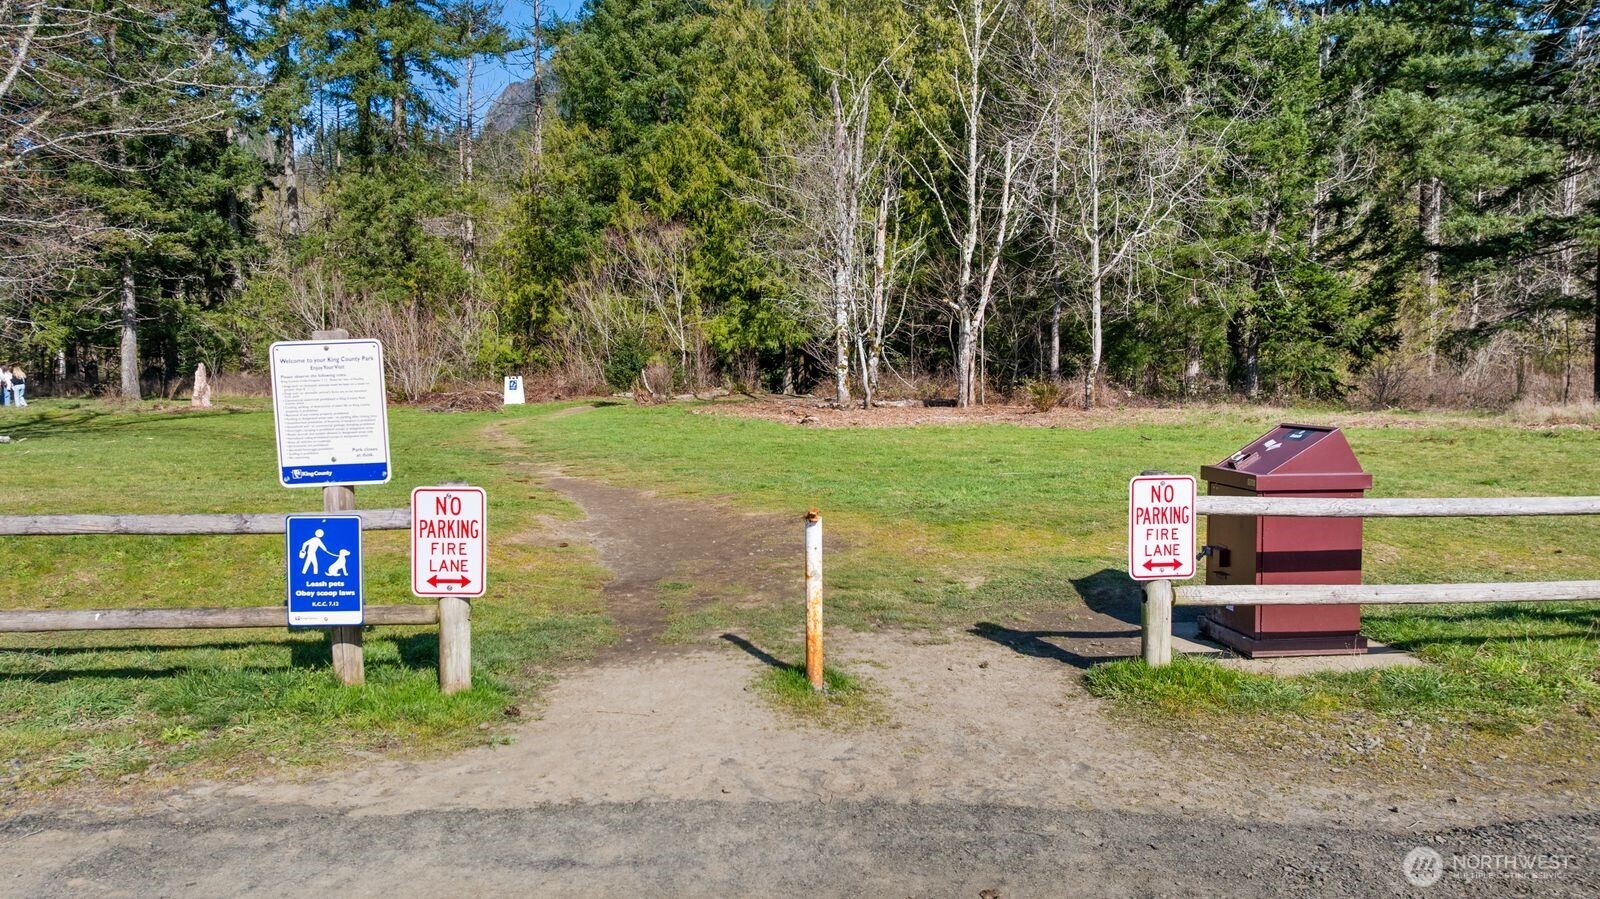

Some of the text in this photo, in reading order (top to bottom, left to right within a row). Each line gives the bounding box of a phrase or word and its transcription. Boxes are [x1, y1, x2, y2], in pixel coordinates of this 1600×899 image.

[341, 356, 361, 364] County
[1151, 485, 1174, 503] NO
[435, 496, 462, 516] NO
[1136, 506, 1190, 525] PARKING
[419, 519, 479, 539] PARKING
[1146, 528, 1179, 541] FIRE
[431, 542, 468, 556] FIRE
[1144, 544, 1181, 557] LANE
[429, 559, 469, 573] LANE
[295, 590, 315, 598] Obey
